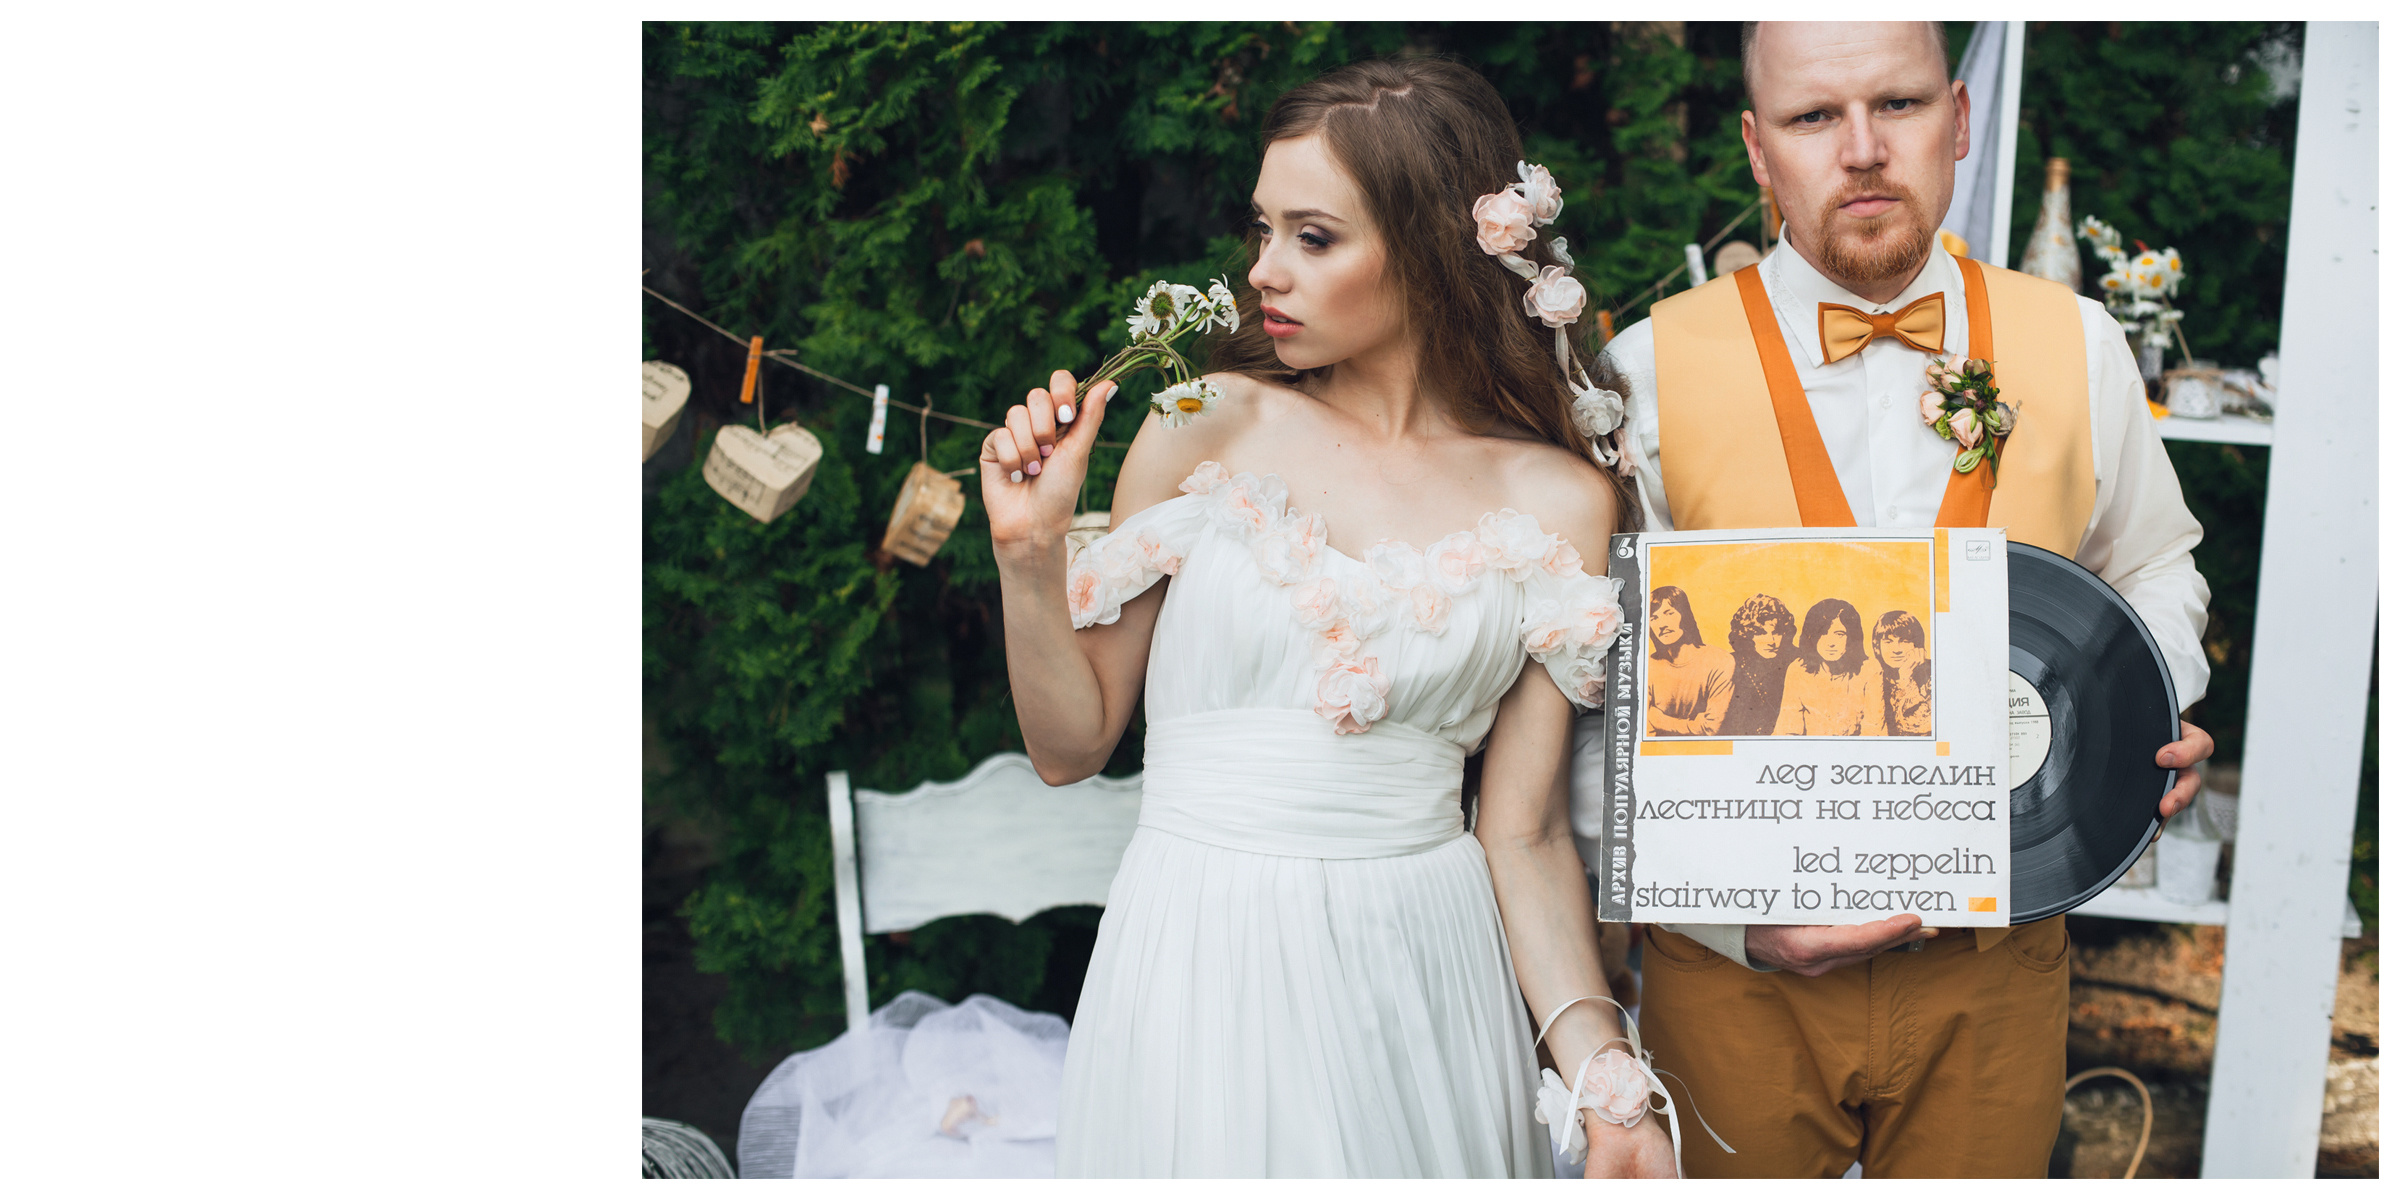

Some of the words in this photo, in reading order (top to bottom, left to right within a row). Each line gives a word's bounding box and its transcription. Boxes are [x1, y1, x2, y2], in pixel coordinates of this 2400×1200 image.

[1616, 537, 1635, 559] 6
[1617, 622, 1633, 700] МУЗЫКИ
[1613, 705, 1631, 839] ПОПУЛЯРНОЙ
[1831, 764, 1995, 786] зеппелин
[1637, 800, 1802, 824] лестница
[1816, 800, 1861, 820] на
[1873, 792, 1996, 821] небеса
[1611, 845, 1627, 906] АРХИВ
[1793, 846, 1843, 873] led
[1854, 847, 1996, 880] zeppelin
[1635, 881, 1781, 915] stairway
[1792, 883, 1822, 910] to
[1831, 883, 1957, 912] heaven
